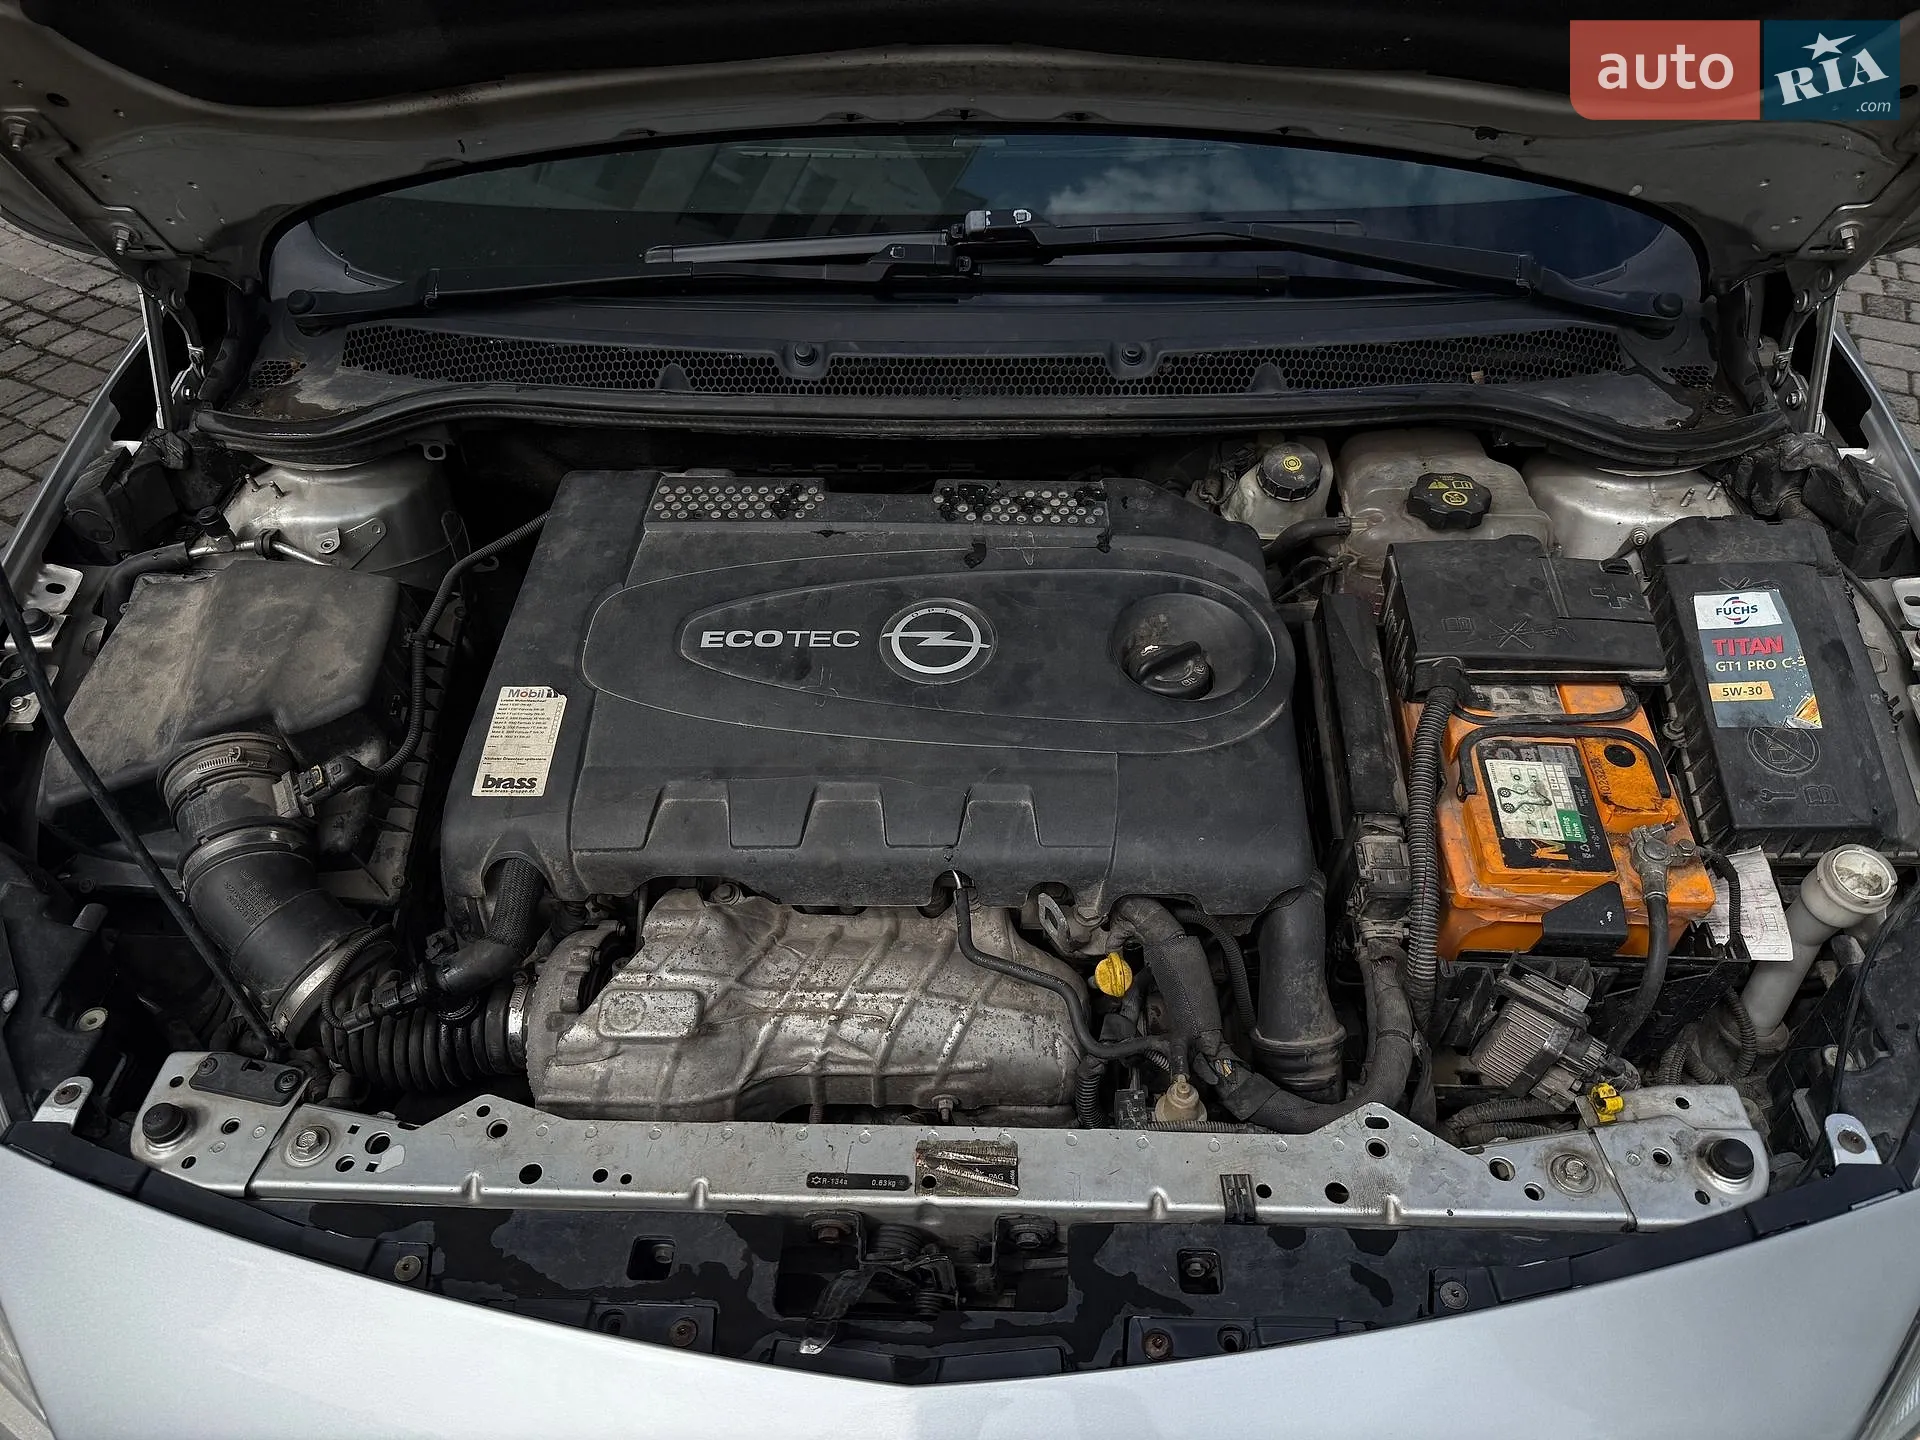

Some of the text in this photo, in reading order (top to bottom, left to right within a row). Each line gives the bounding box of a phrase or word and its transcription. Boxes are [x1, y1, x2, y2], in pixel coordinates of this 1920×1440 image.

[1716, 604, 1758, 616] FUCHS
[700, 630, 860, 648] ECOTEC
[1712, 635, 1784, 656] TITAN
[1715, 661, 1742, 672] GT1
[1748, 659, 1777, 670] PRO
[508, 689, 545, 698] Mobil
[1722, 686, 1763, 697] 5W-30
[482, 774, 537, 789] brass
[1562, 815, 1573, 837] Timing
[1573, 822, 1582, 838] Drive
